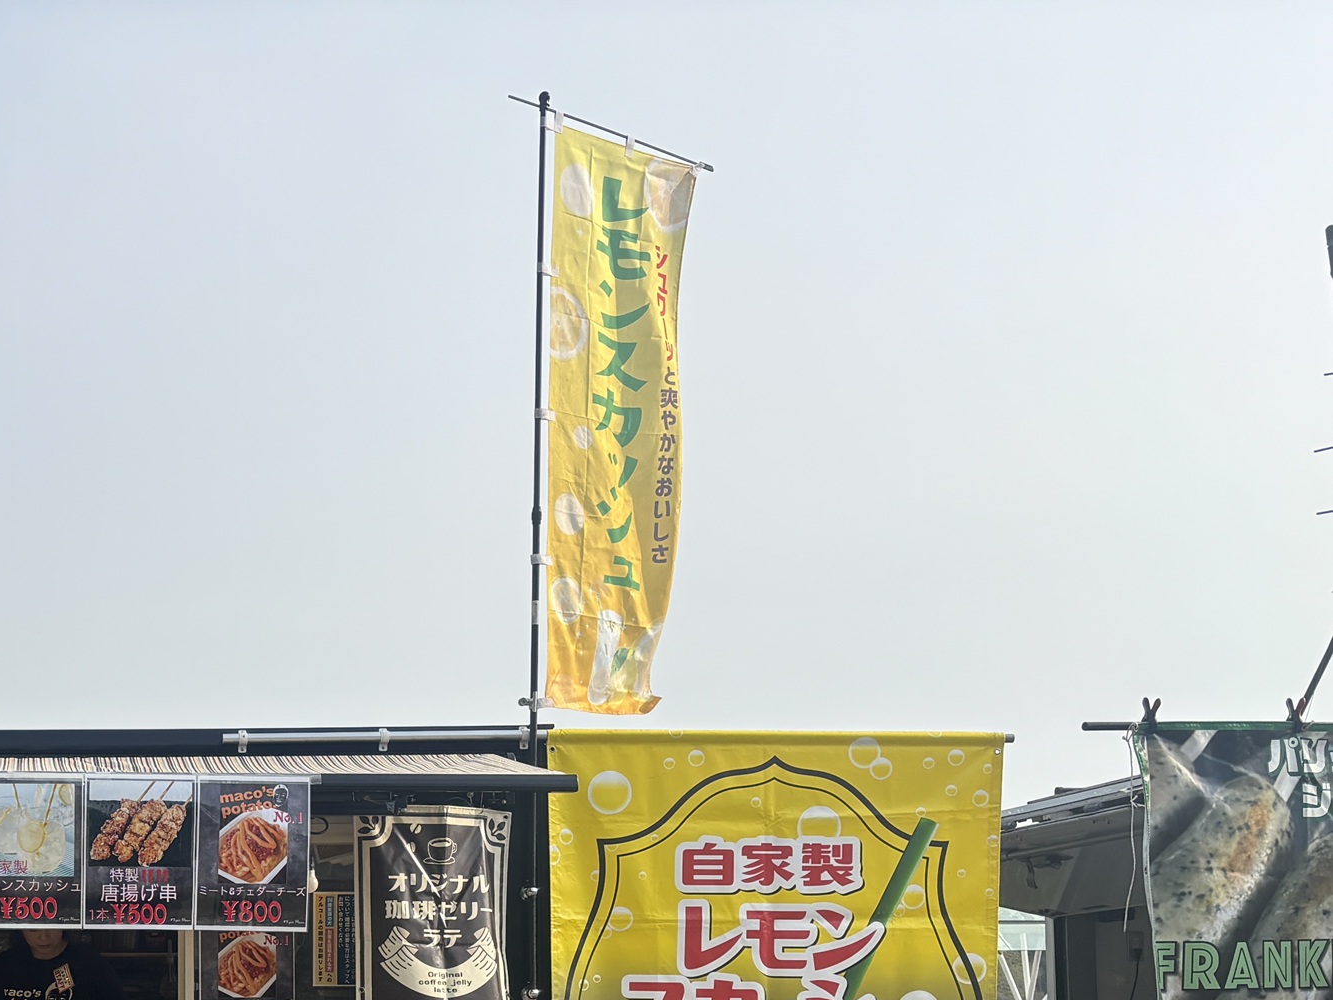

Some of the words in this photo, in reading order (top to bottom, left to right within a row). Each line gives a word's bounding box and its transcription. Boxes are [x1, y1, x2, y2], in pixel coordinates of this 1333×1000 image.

[595, 175, 650, 592] レモンスカッシュ
[219, 785, 274, 804] maco's
[679, 840, 855, 888] 自家製
[100, 884, 178, 903] 唐揚げ串
[199, 885, 306, 898] ミート&チェダーチーズ
[388, 872, 490, 895] オリジナル
[88, 908, 109, 922] 1本
[110, 903, 168, 925] ¥500
[220, 899, 282, 923] ¥800
[384, 900, 493, 921] 珈琲ゼリー
[423, 929, 462, 949] ラテ
[681, 903, 883, 972] レモン
[428, 971, 463, 979] Original
[1156, 940, 1333, 990] FRANK
[451, 979, 473, 987] jelly
